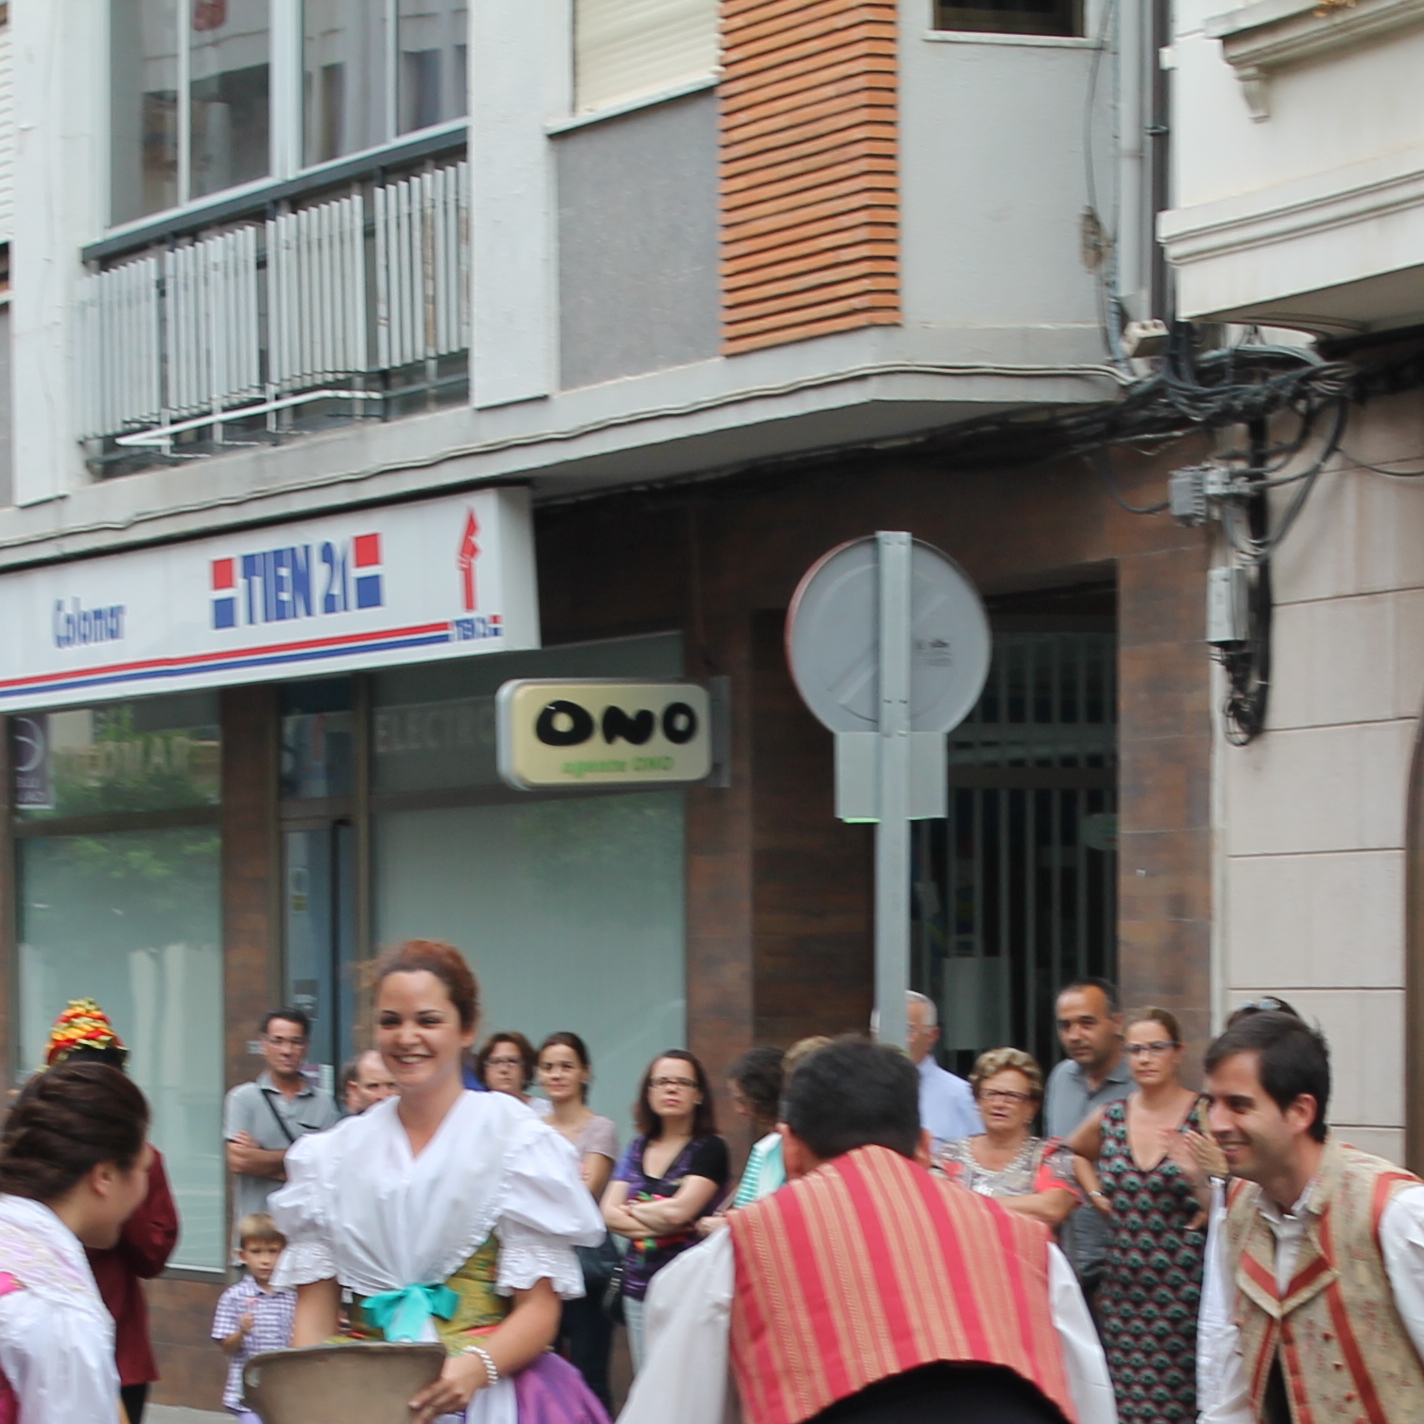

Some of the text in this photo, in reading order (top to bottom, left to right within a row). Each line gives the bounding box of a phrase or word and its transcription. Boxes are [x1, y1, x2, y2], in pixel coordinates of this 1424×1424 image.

[241, 540, 351, 624] TIEN 21
[53, 596, 127, 649] Colomar
[536, 700, 697, 746] ONO
